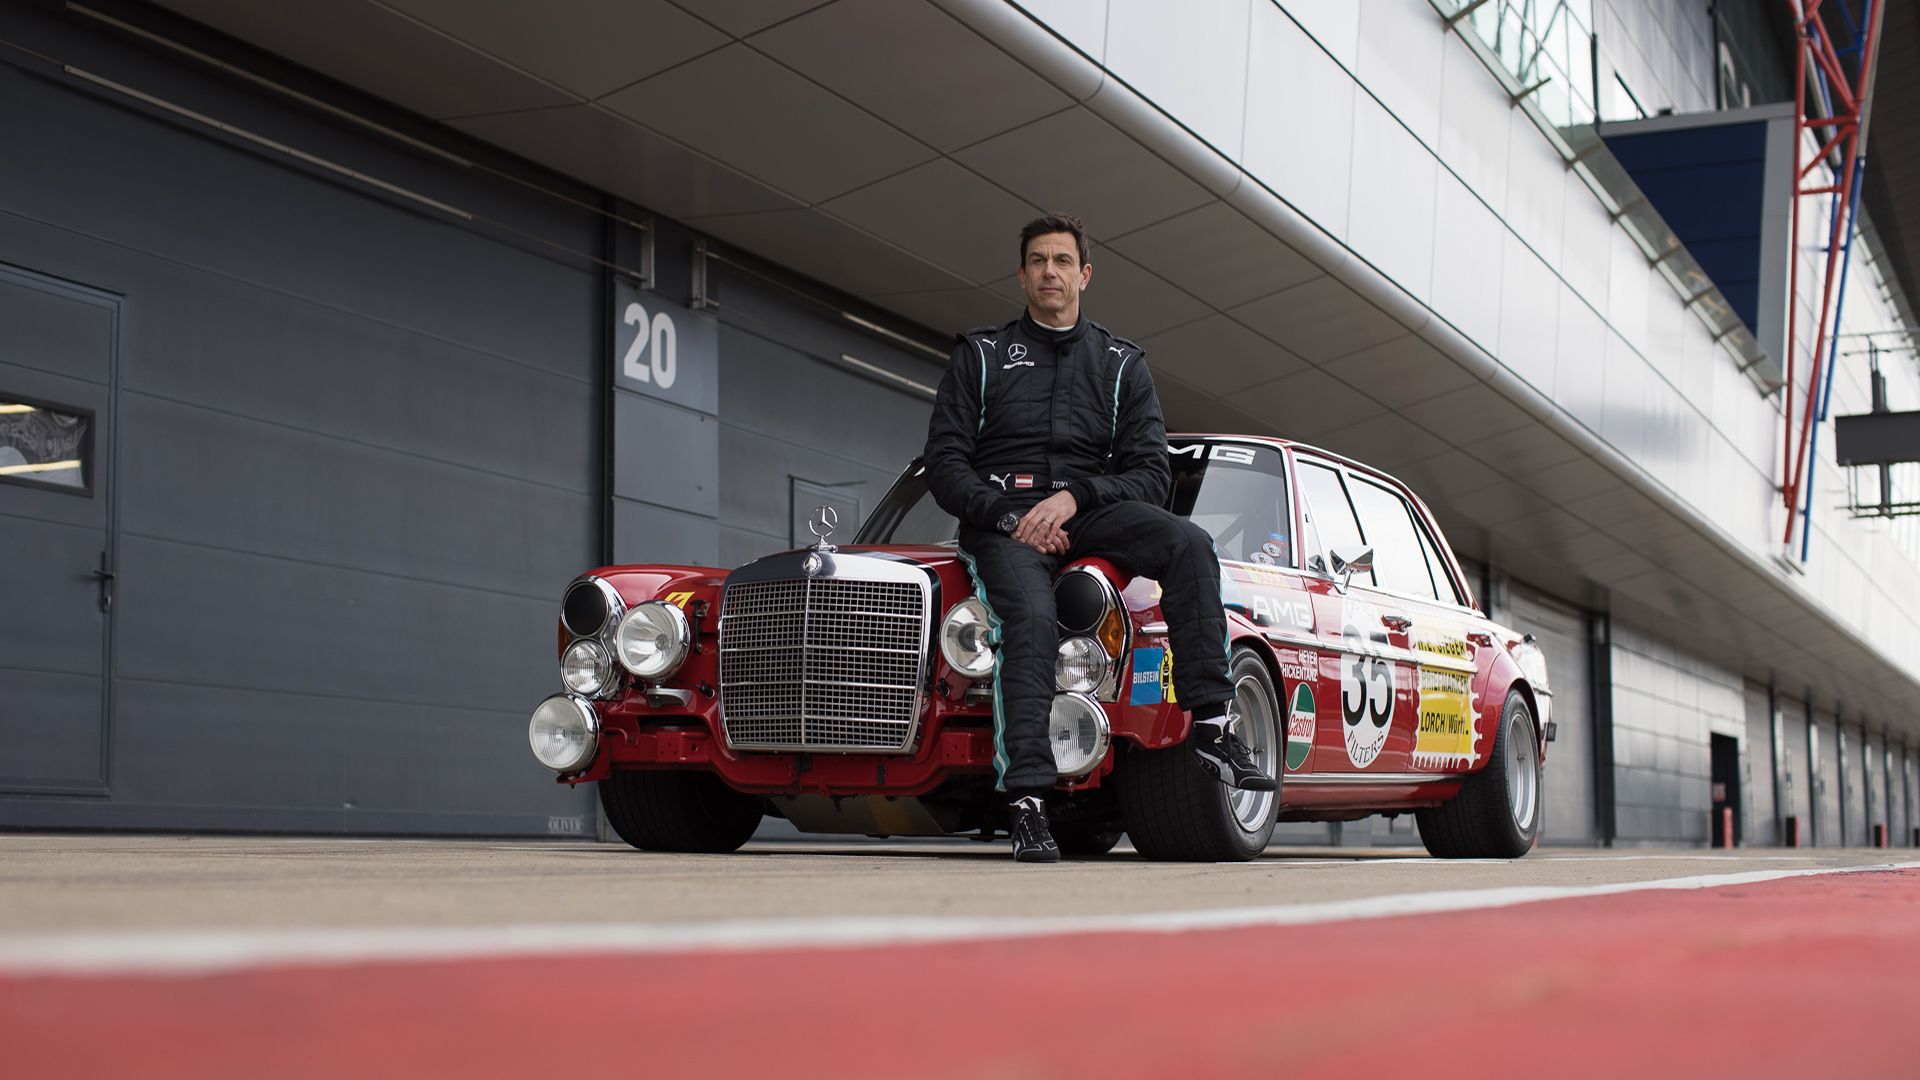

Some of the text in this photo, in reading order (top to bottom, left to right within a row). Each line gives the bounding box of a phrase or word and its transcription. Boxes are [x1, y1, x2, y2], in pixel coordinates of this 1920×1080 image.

[624, 302, 677, 389] 20
[1168, 444, 1256, 465] MG
[1252, 595, 1313, 629] AMG
[1133, 671, 1160, 684] BILSTEIN
[1281, 663, 1318, 682] HICKENTANZ
[1342, 624, 1393, 729] 35
[1288, 713, 1315, 738] Castrol
[1347, 730, 1384, 763] FILTERS
